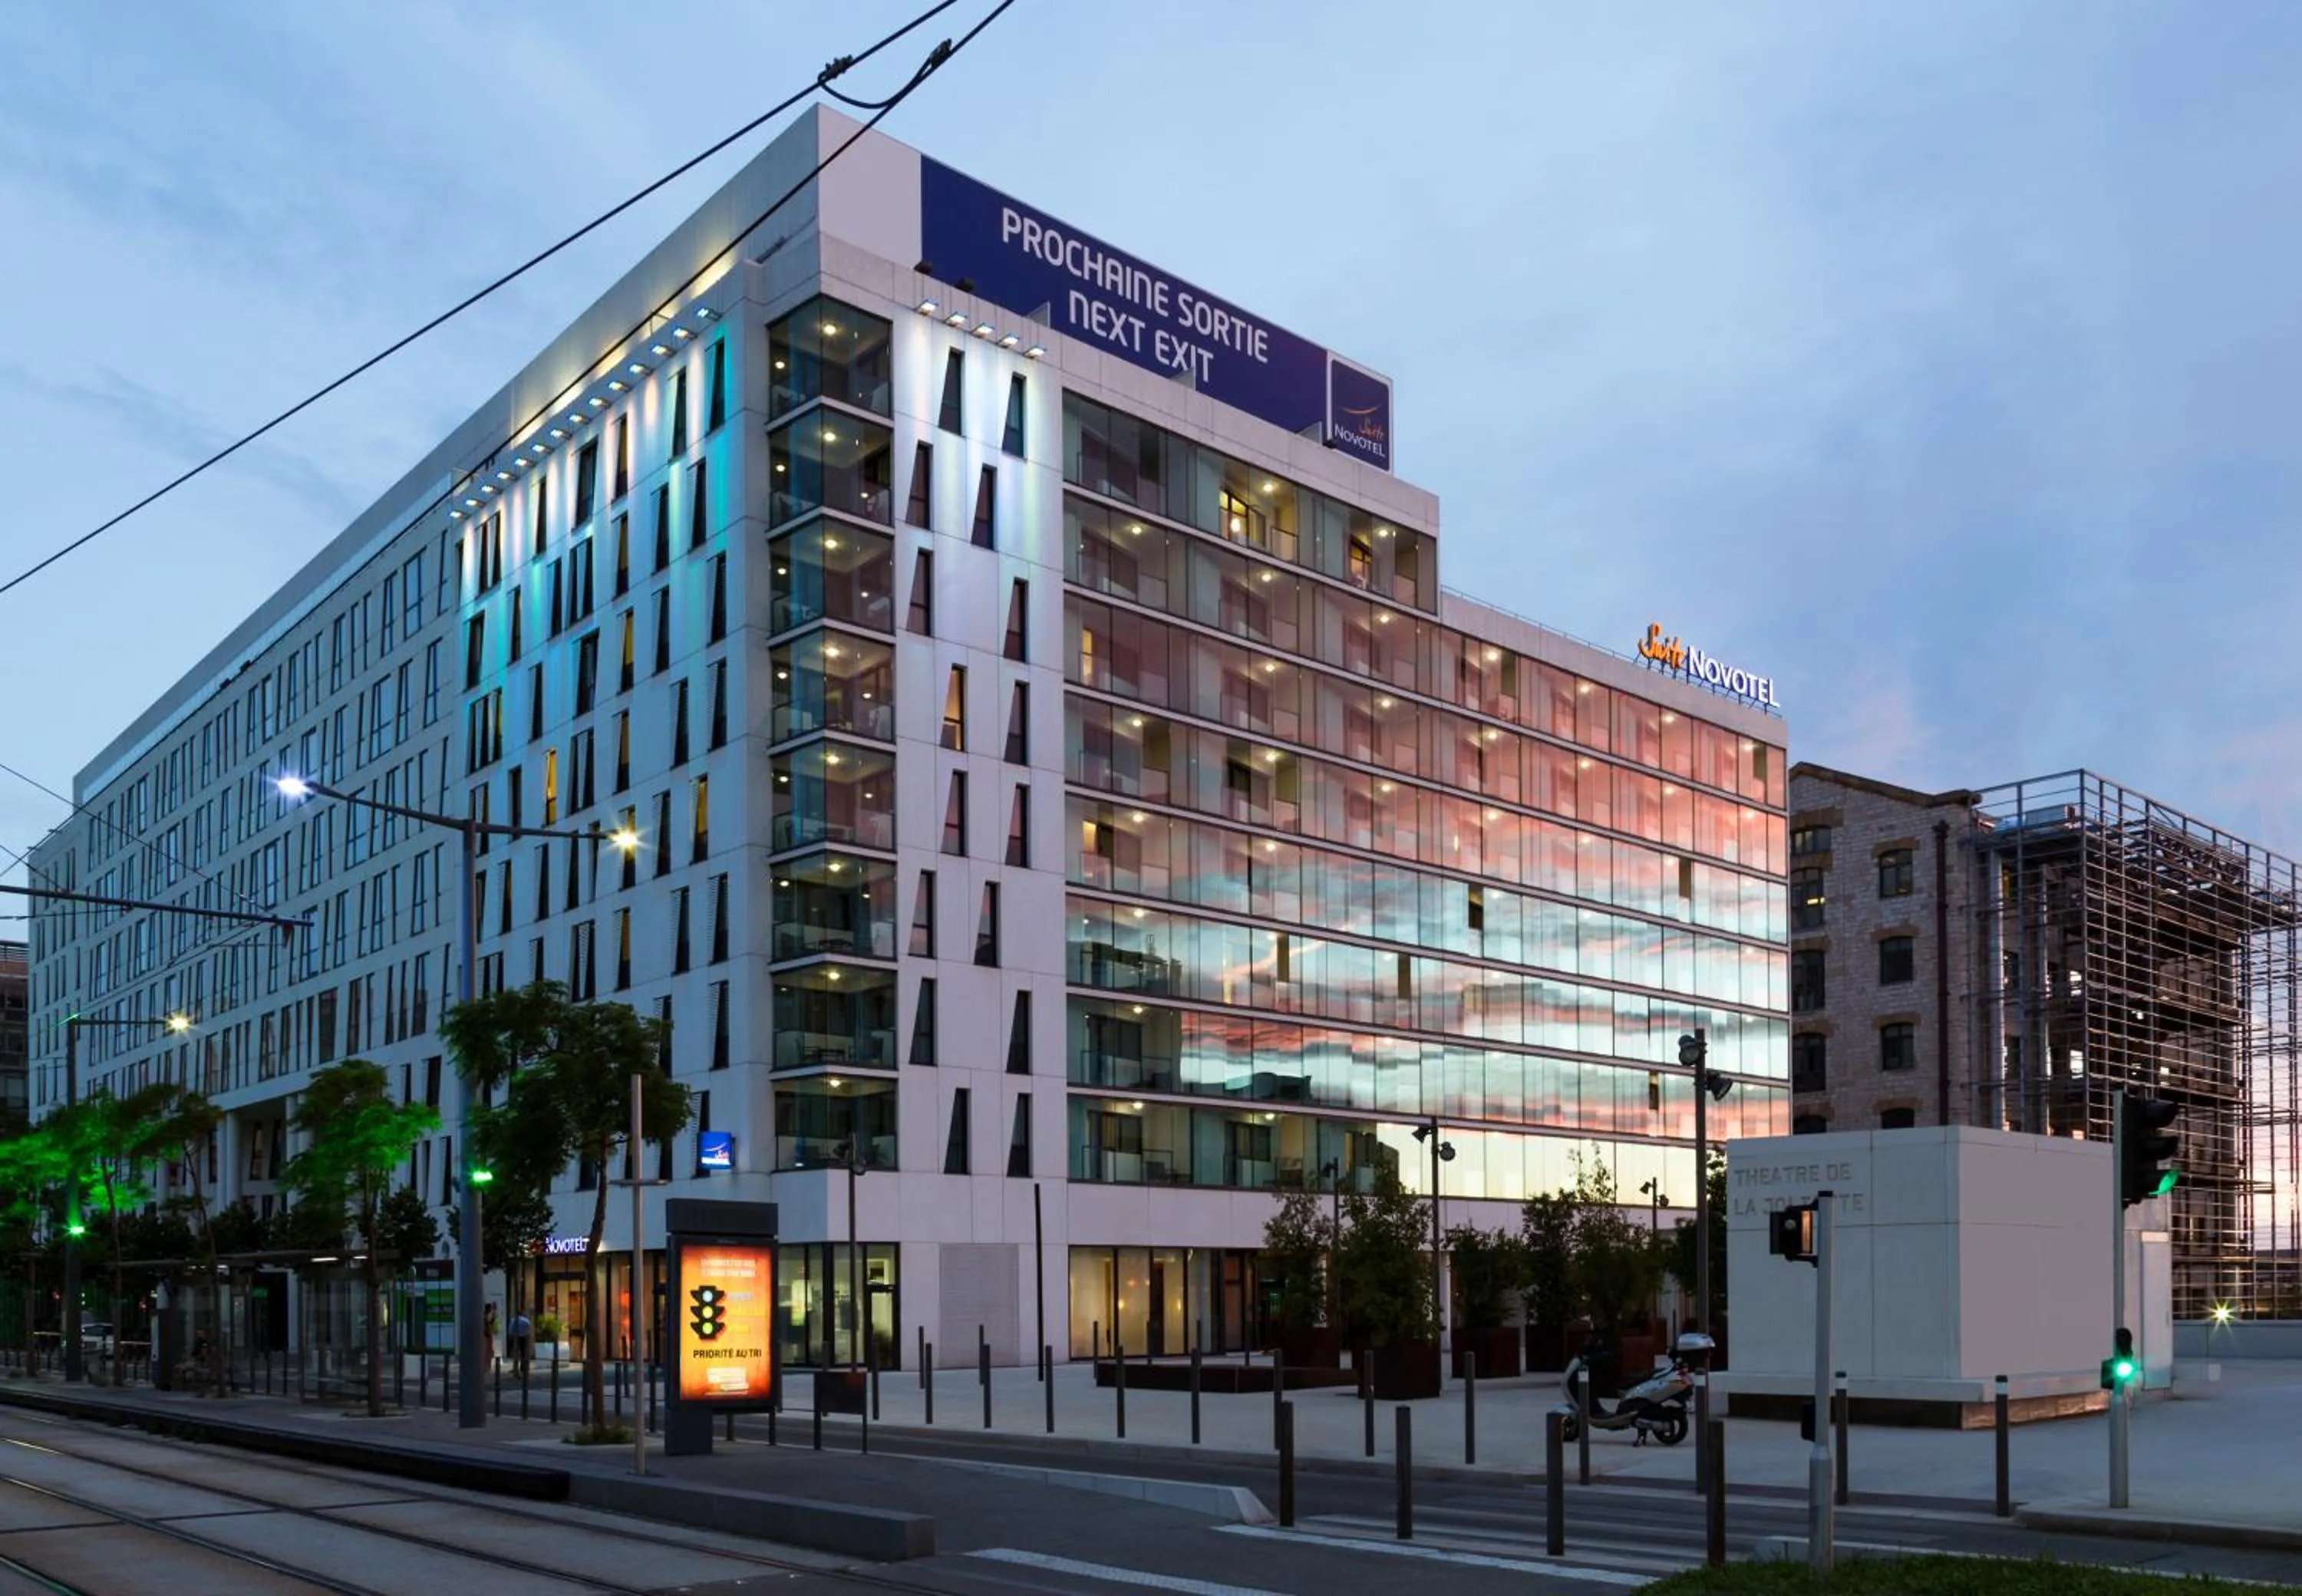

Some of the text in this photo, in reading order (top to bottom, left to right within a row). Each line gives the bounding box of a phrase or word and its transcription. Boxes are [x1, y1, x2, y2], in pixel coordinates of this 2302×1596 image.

[1002, 208, 1268, 364] PROCHAINE SORTIE
[1070, 289, 1214, 383] NEXT EXIT
[1334, 423, 1386, 458] NOVOTEL
[1687, 645, 1781, 707] NOVOTEL
[1734, 1163, 1851, 1186] THEATRE DE
[1734, 1198, 1756, 1216] LA
[546, 1236, 586, 1252] NOVOTEL
[749, 1349, 761, 1357] TRI
